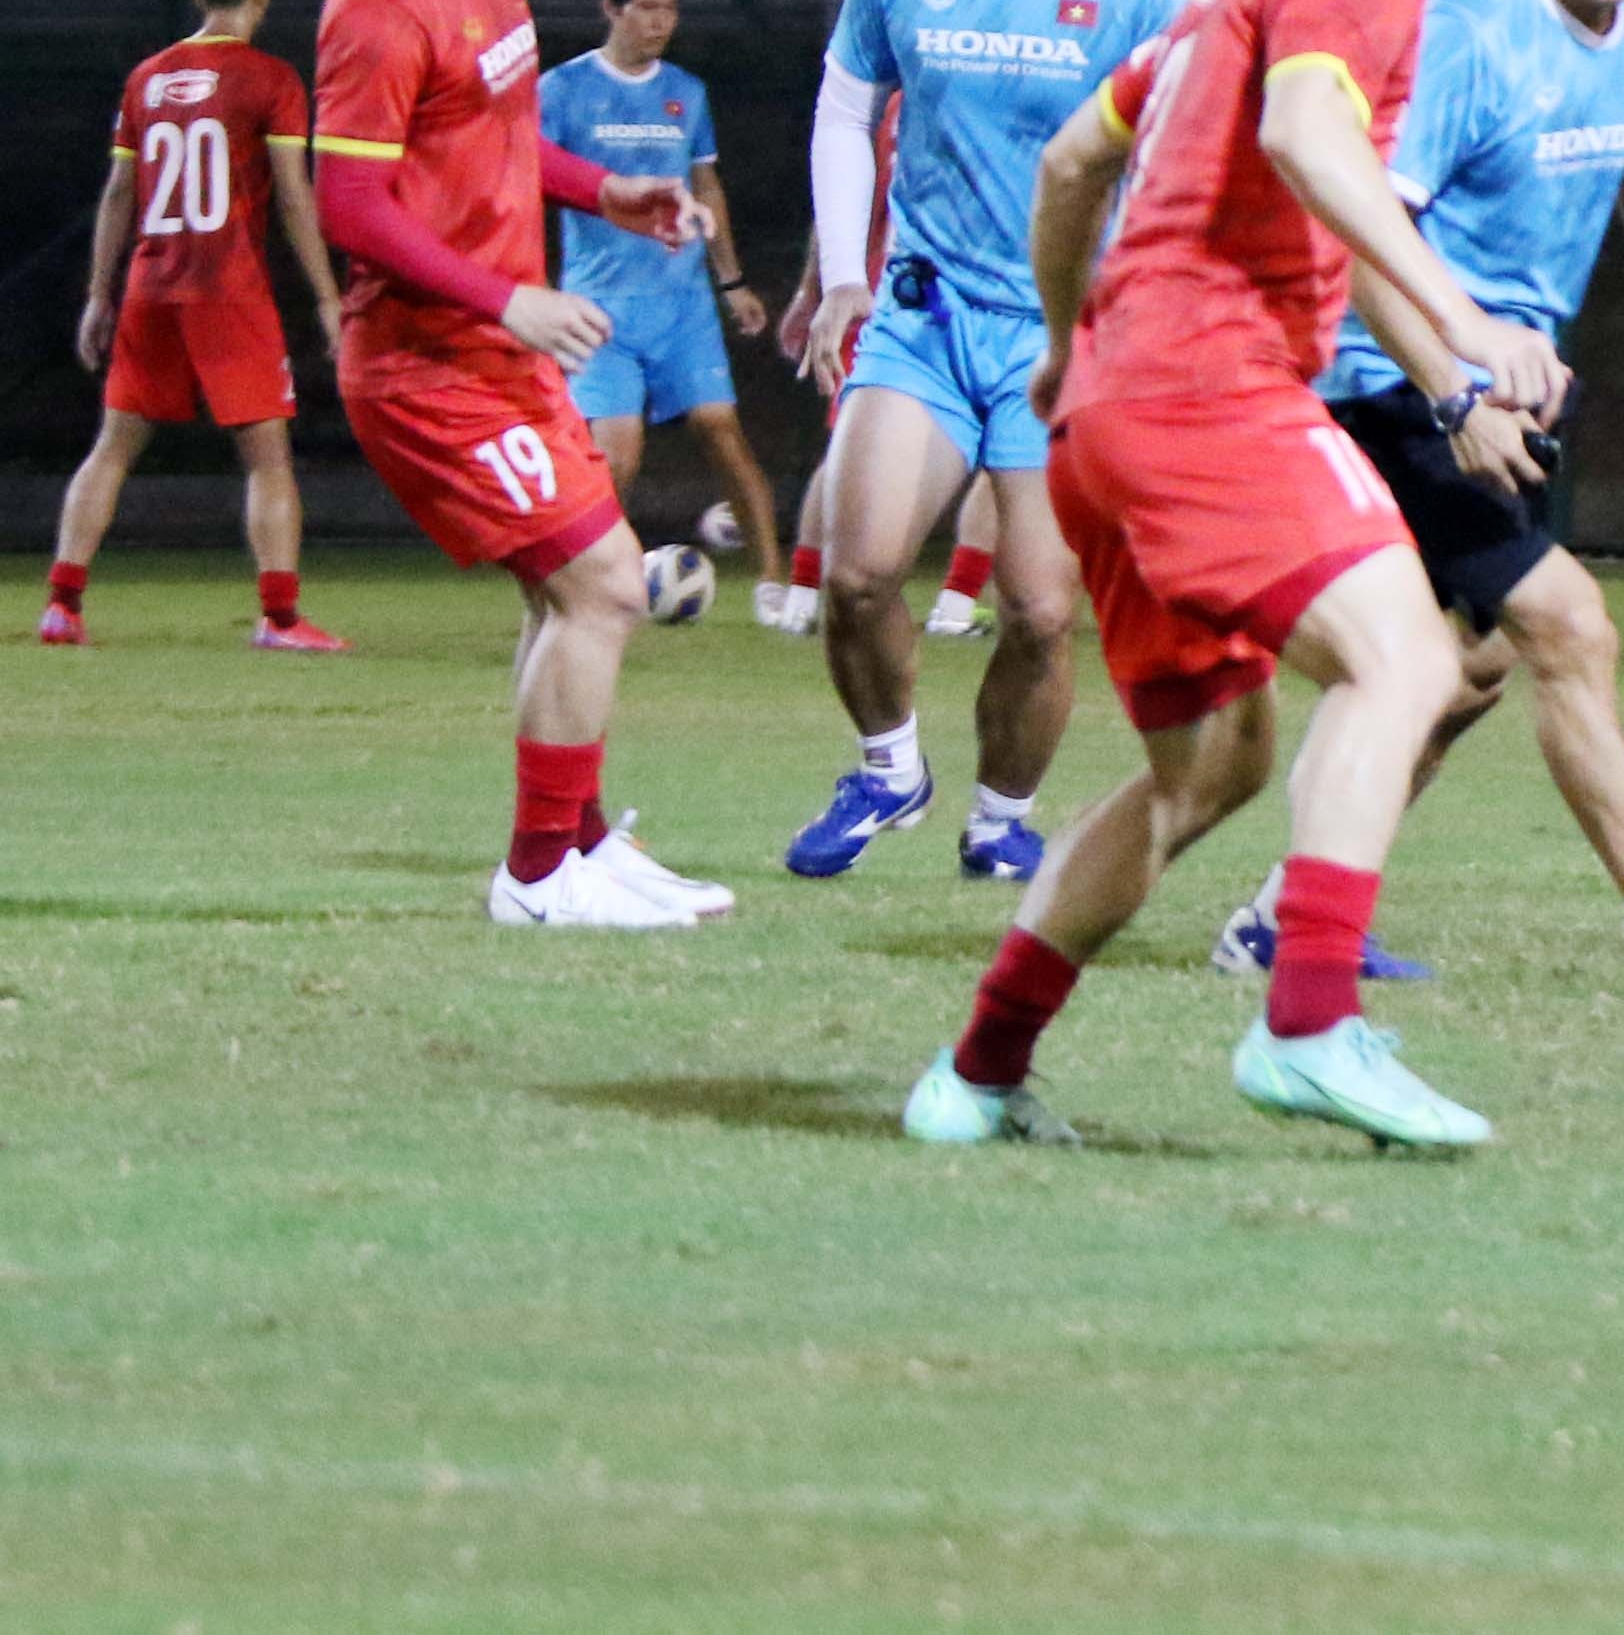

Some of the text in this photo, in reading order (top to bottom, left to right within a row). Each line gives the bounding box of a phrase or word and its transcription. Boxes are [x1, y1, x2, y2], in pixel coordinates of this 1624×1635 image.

[915, 28, 1090, 65] HONDA
[143, 117, 230, 235] 20
[474, 424, 558, 515] 19
